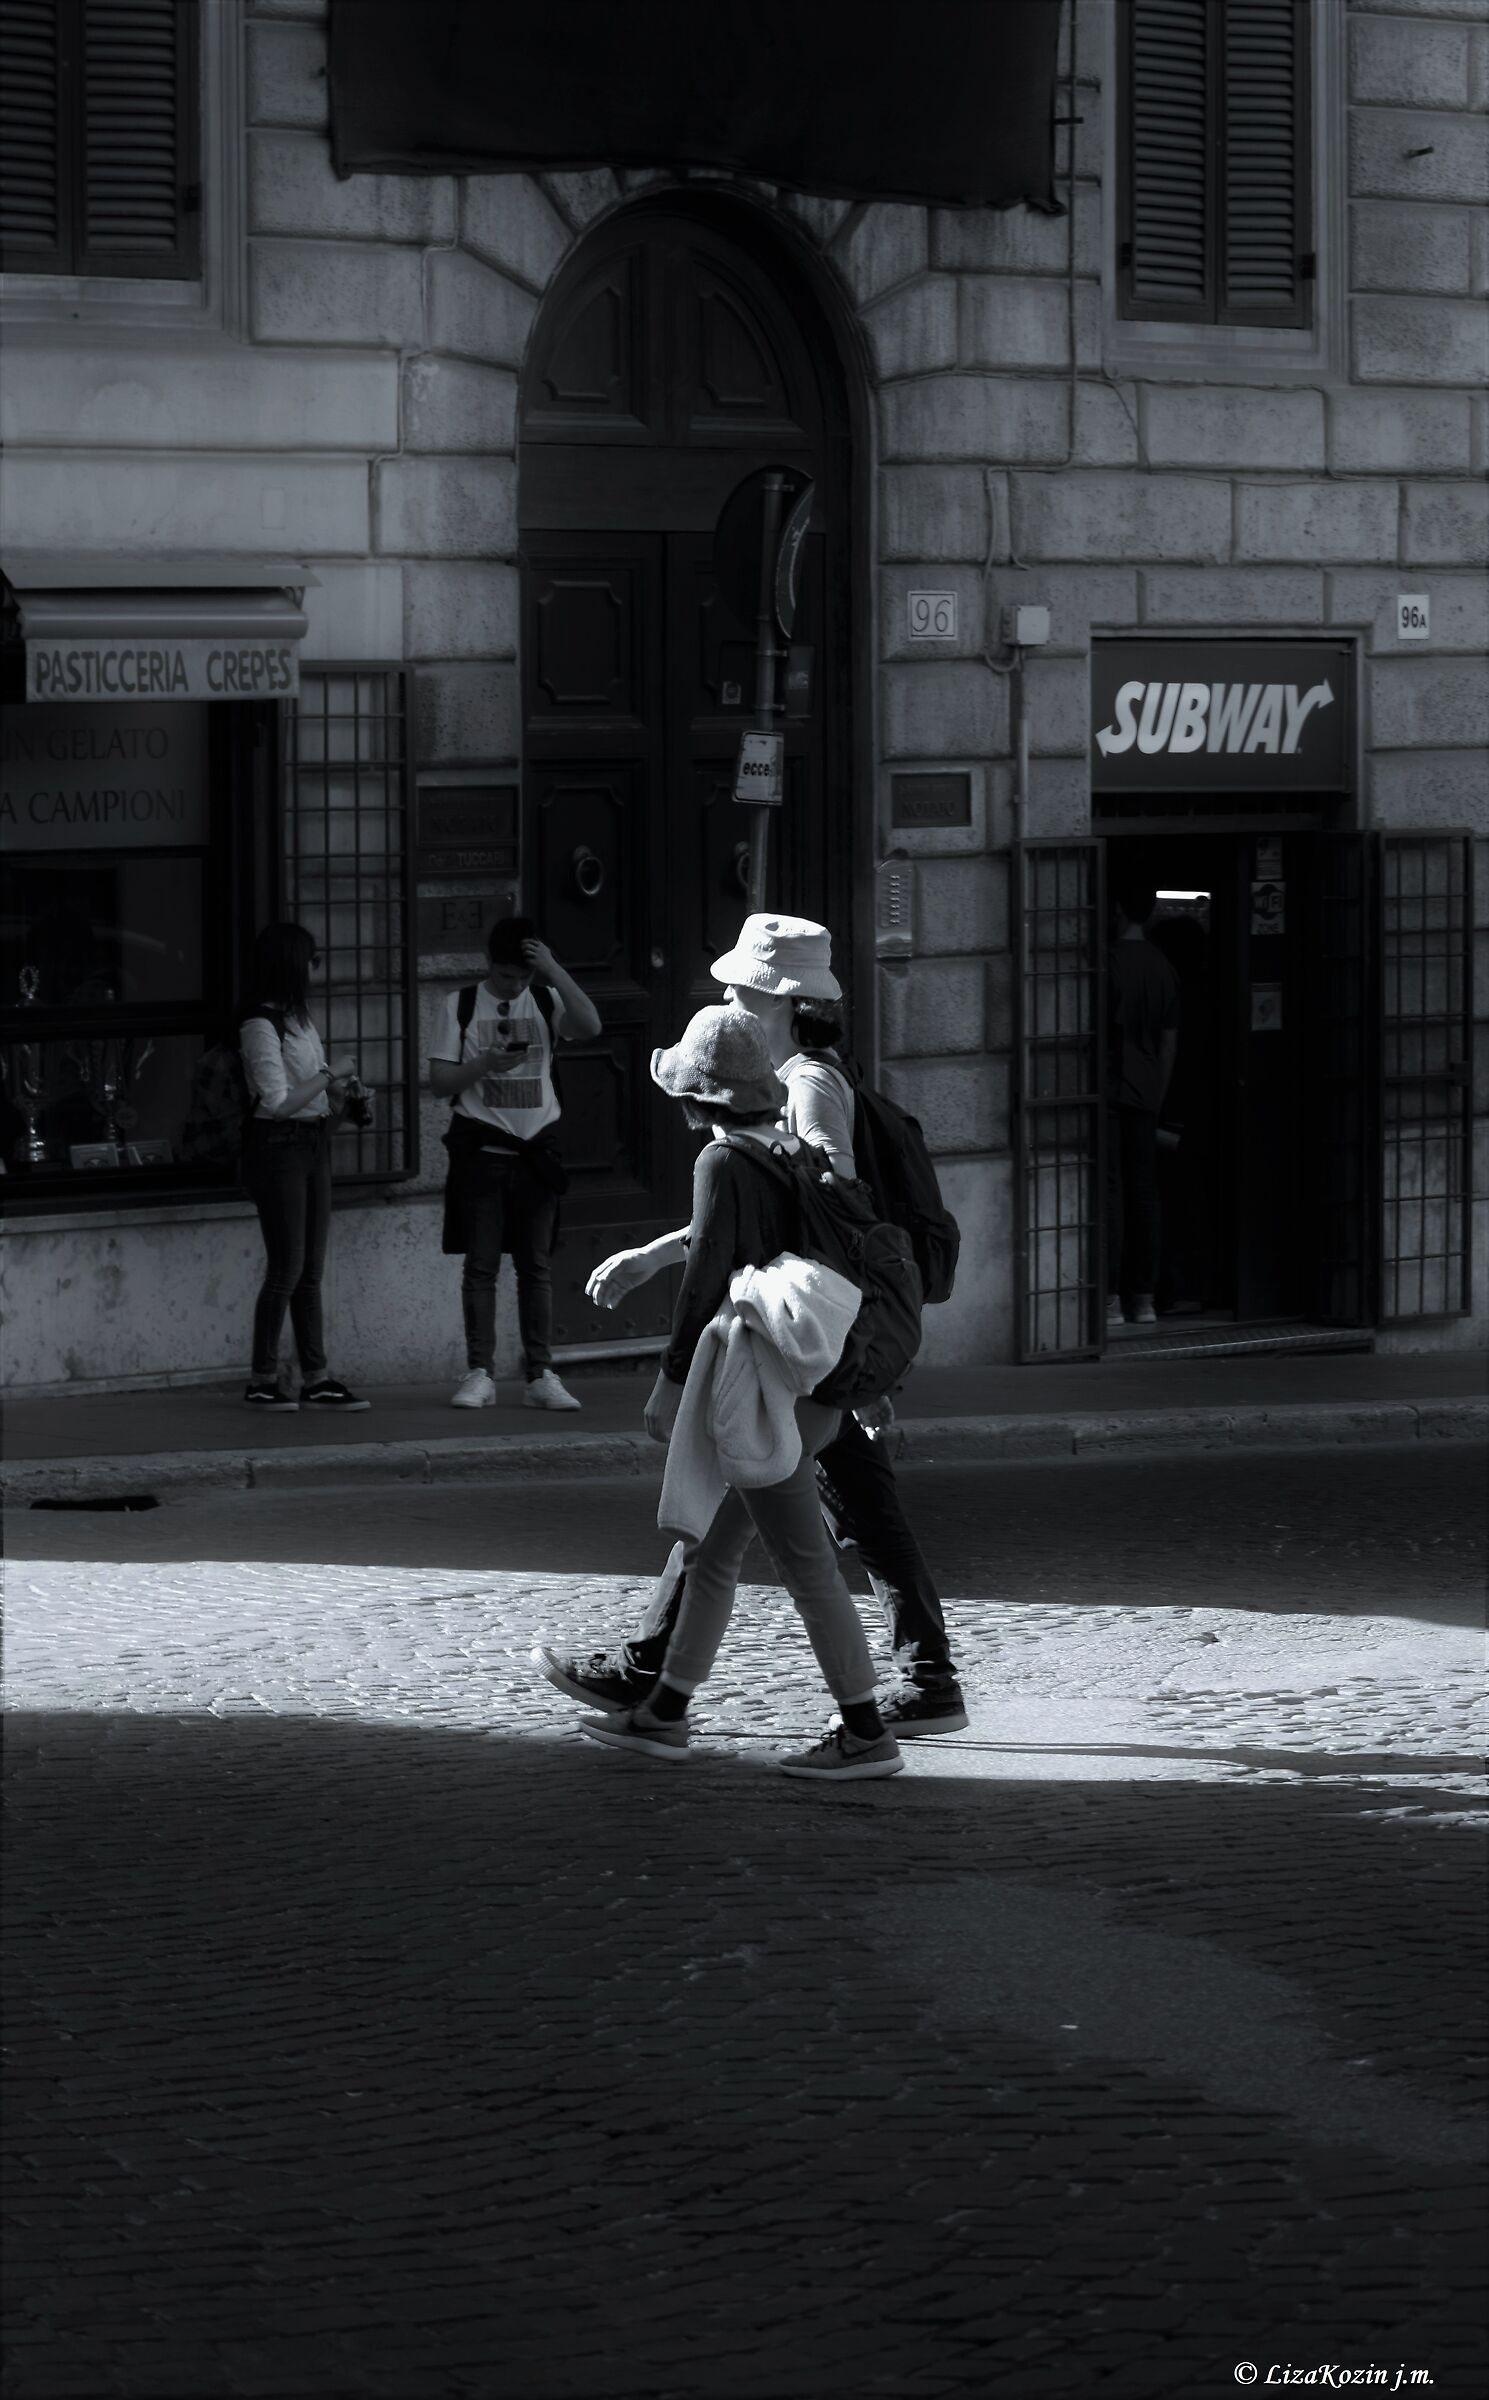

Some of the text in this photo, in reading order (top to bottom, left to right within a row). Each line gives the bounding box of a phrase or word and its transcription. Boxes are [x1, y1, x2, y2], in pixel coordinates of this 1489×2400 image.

[912, 599, 951, 632] 96
[1401, 606, 1428, 629] 96A
[36, 648, 292, 693] PASTICCERIA CREPES
[1095, 678, 1335, 758] SUBWAY
[47, 727, 169, 761] GELATO
[28, 789, 184, 824] CAMPIONI
